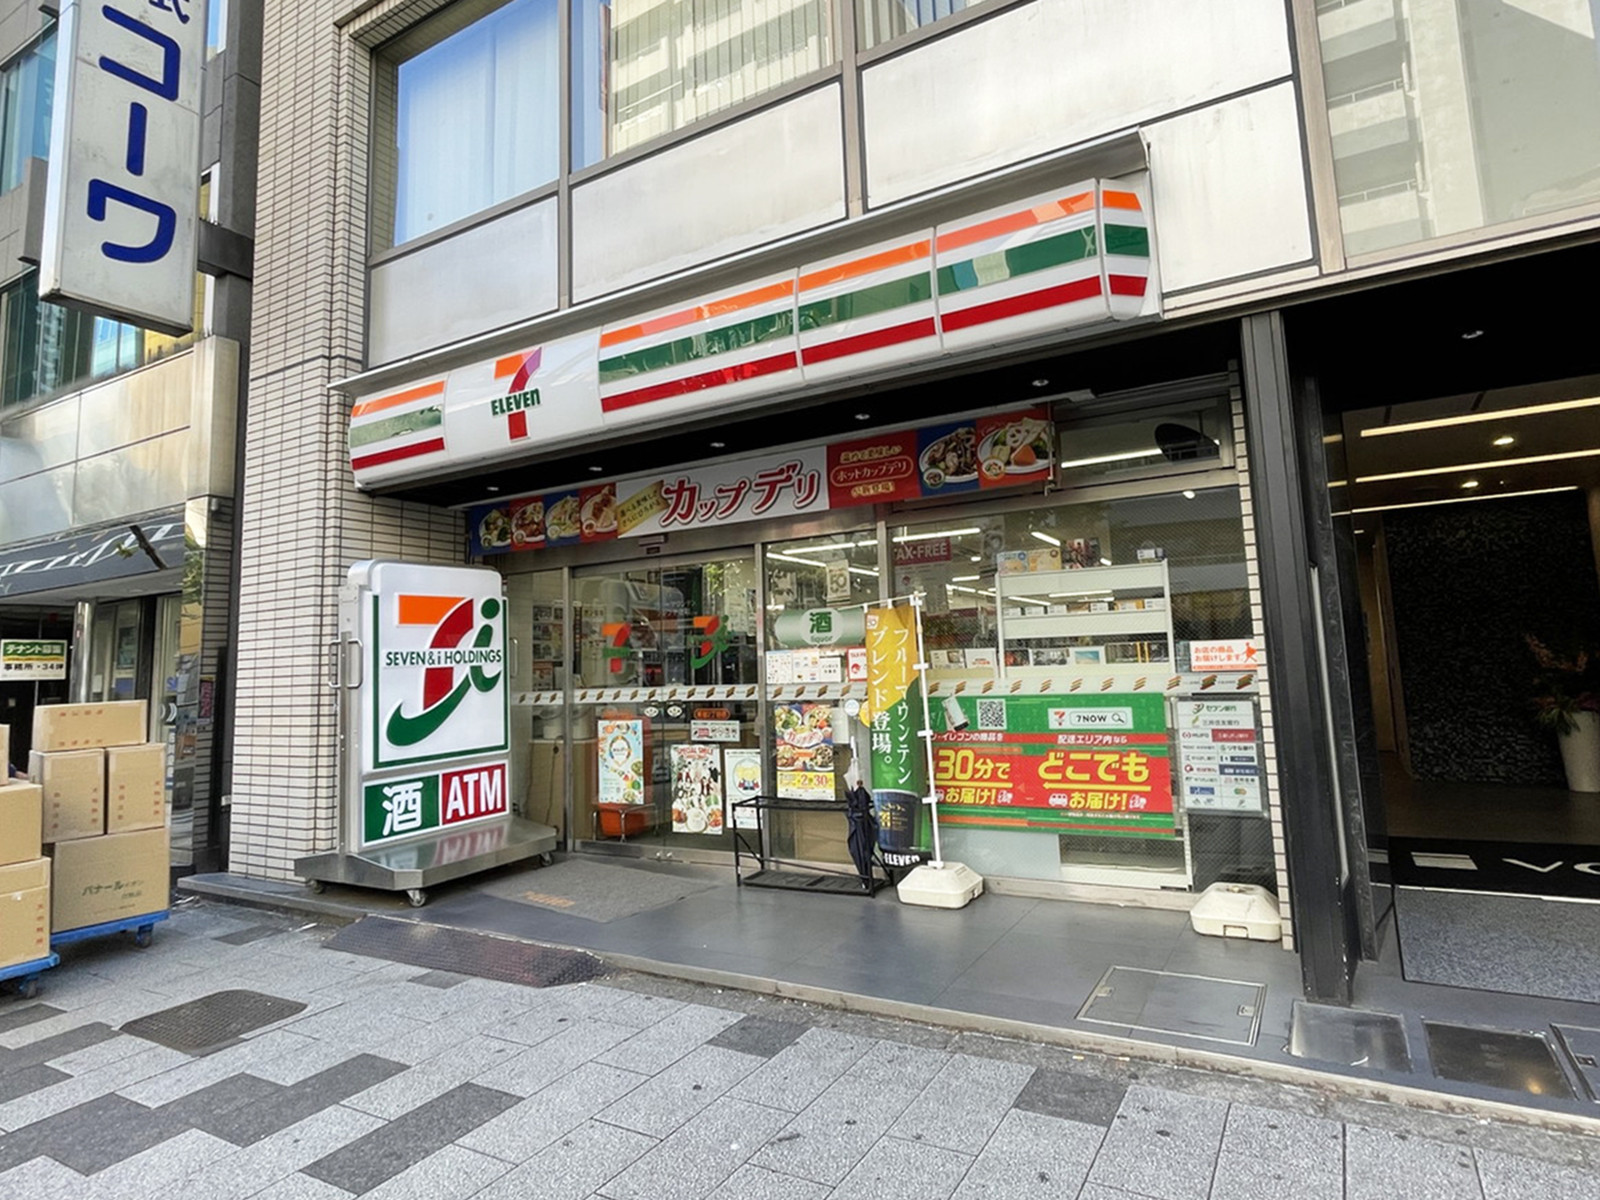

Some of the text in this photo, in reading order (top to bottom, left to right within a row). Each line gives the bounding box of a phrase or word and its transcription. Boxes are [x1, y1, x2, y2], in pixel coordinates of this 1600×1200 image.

[837, 461, 907, 481] ホットカップデリ
[660, 460, 819, 527] カップデリ
[809, 611, 832, 633] 酒
[444, 648, 502, 665] HOLDINGS
[1076, 714, 1107, 723] 7NOW
[935, 749, 1011, 780] 30分で
[1038, 751, 1149, 783] どこでも
[382, 782, 423, 836] 酒
[446, 768, 502, 825] ATM
